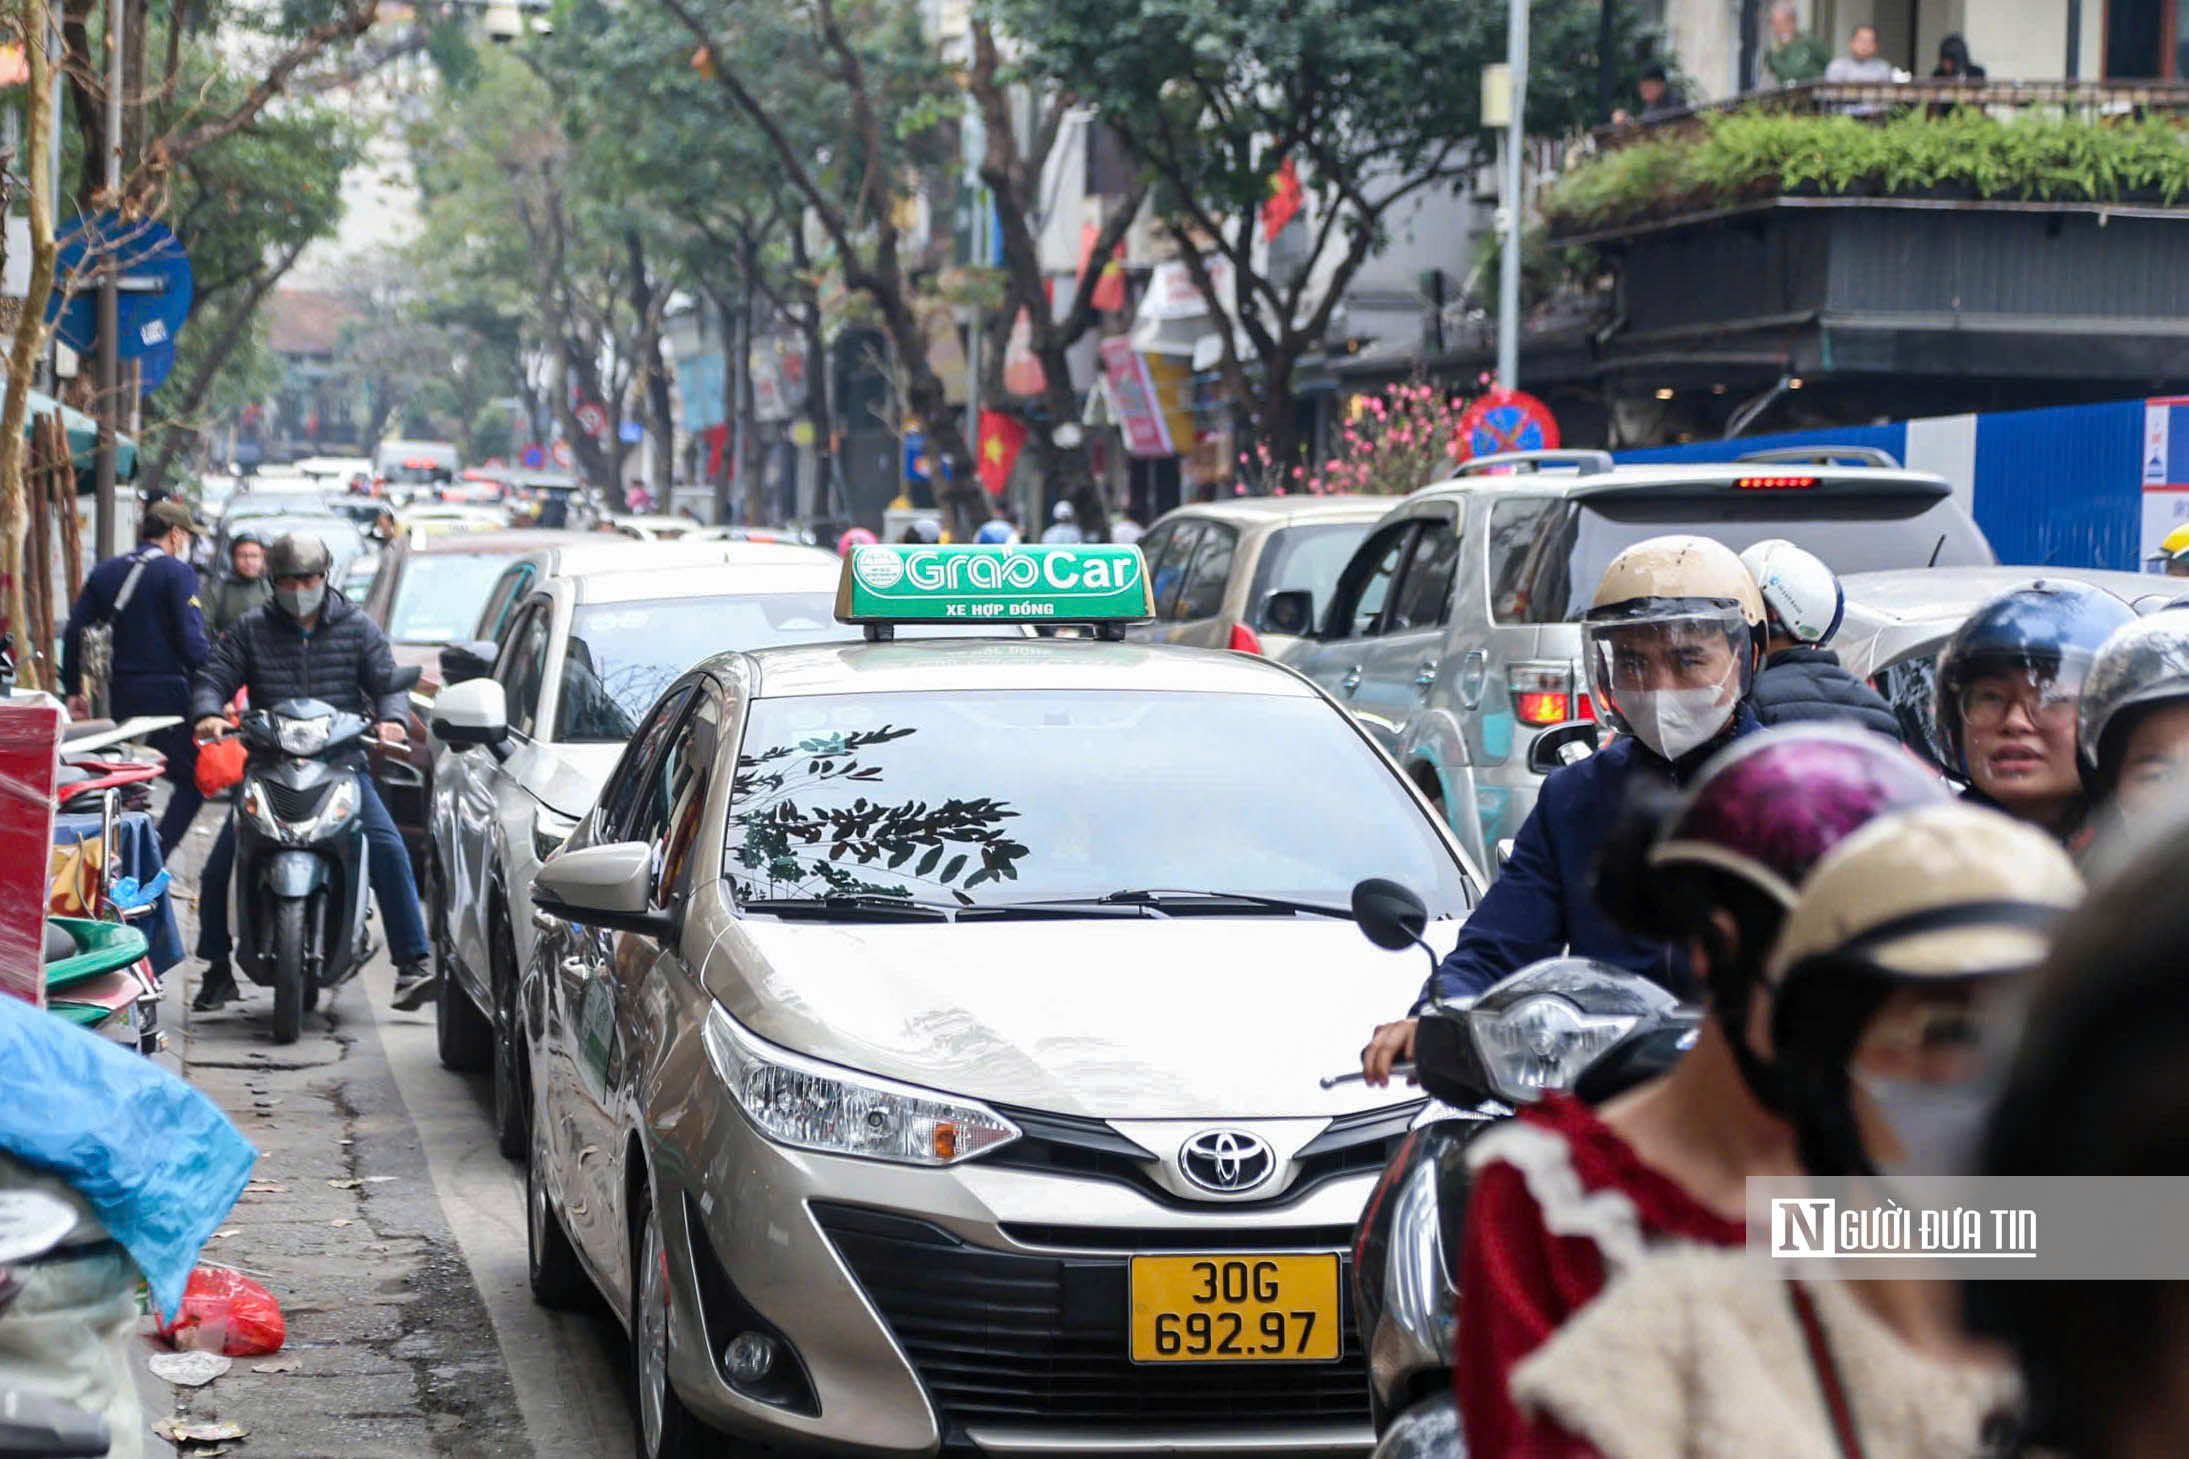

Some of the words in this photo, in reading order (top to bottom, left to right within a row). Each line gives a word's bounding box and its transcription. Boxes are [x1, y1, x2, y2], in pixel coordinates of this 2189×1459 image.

[946, 604, 967, 616] XE
[972, 602, 1005, 618] HỢP
[1191, 1261, 1279, 1303] 30G
[1155, 1312, 1316, 1354] 692.97
